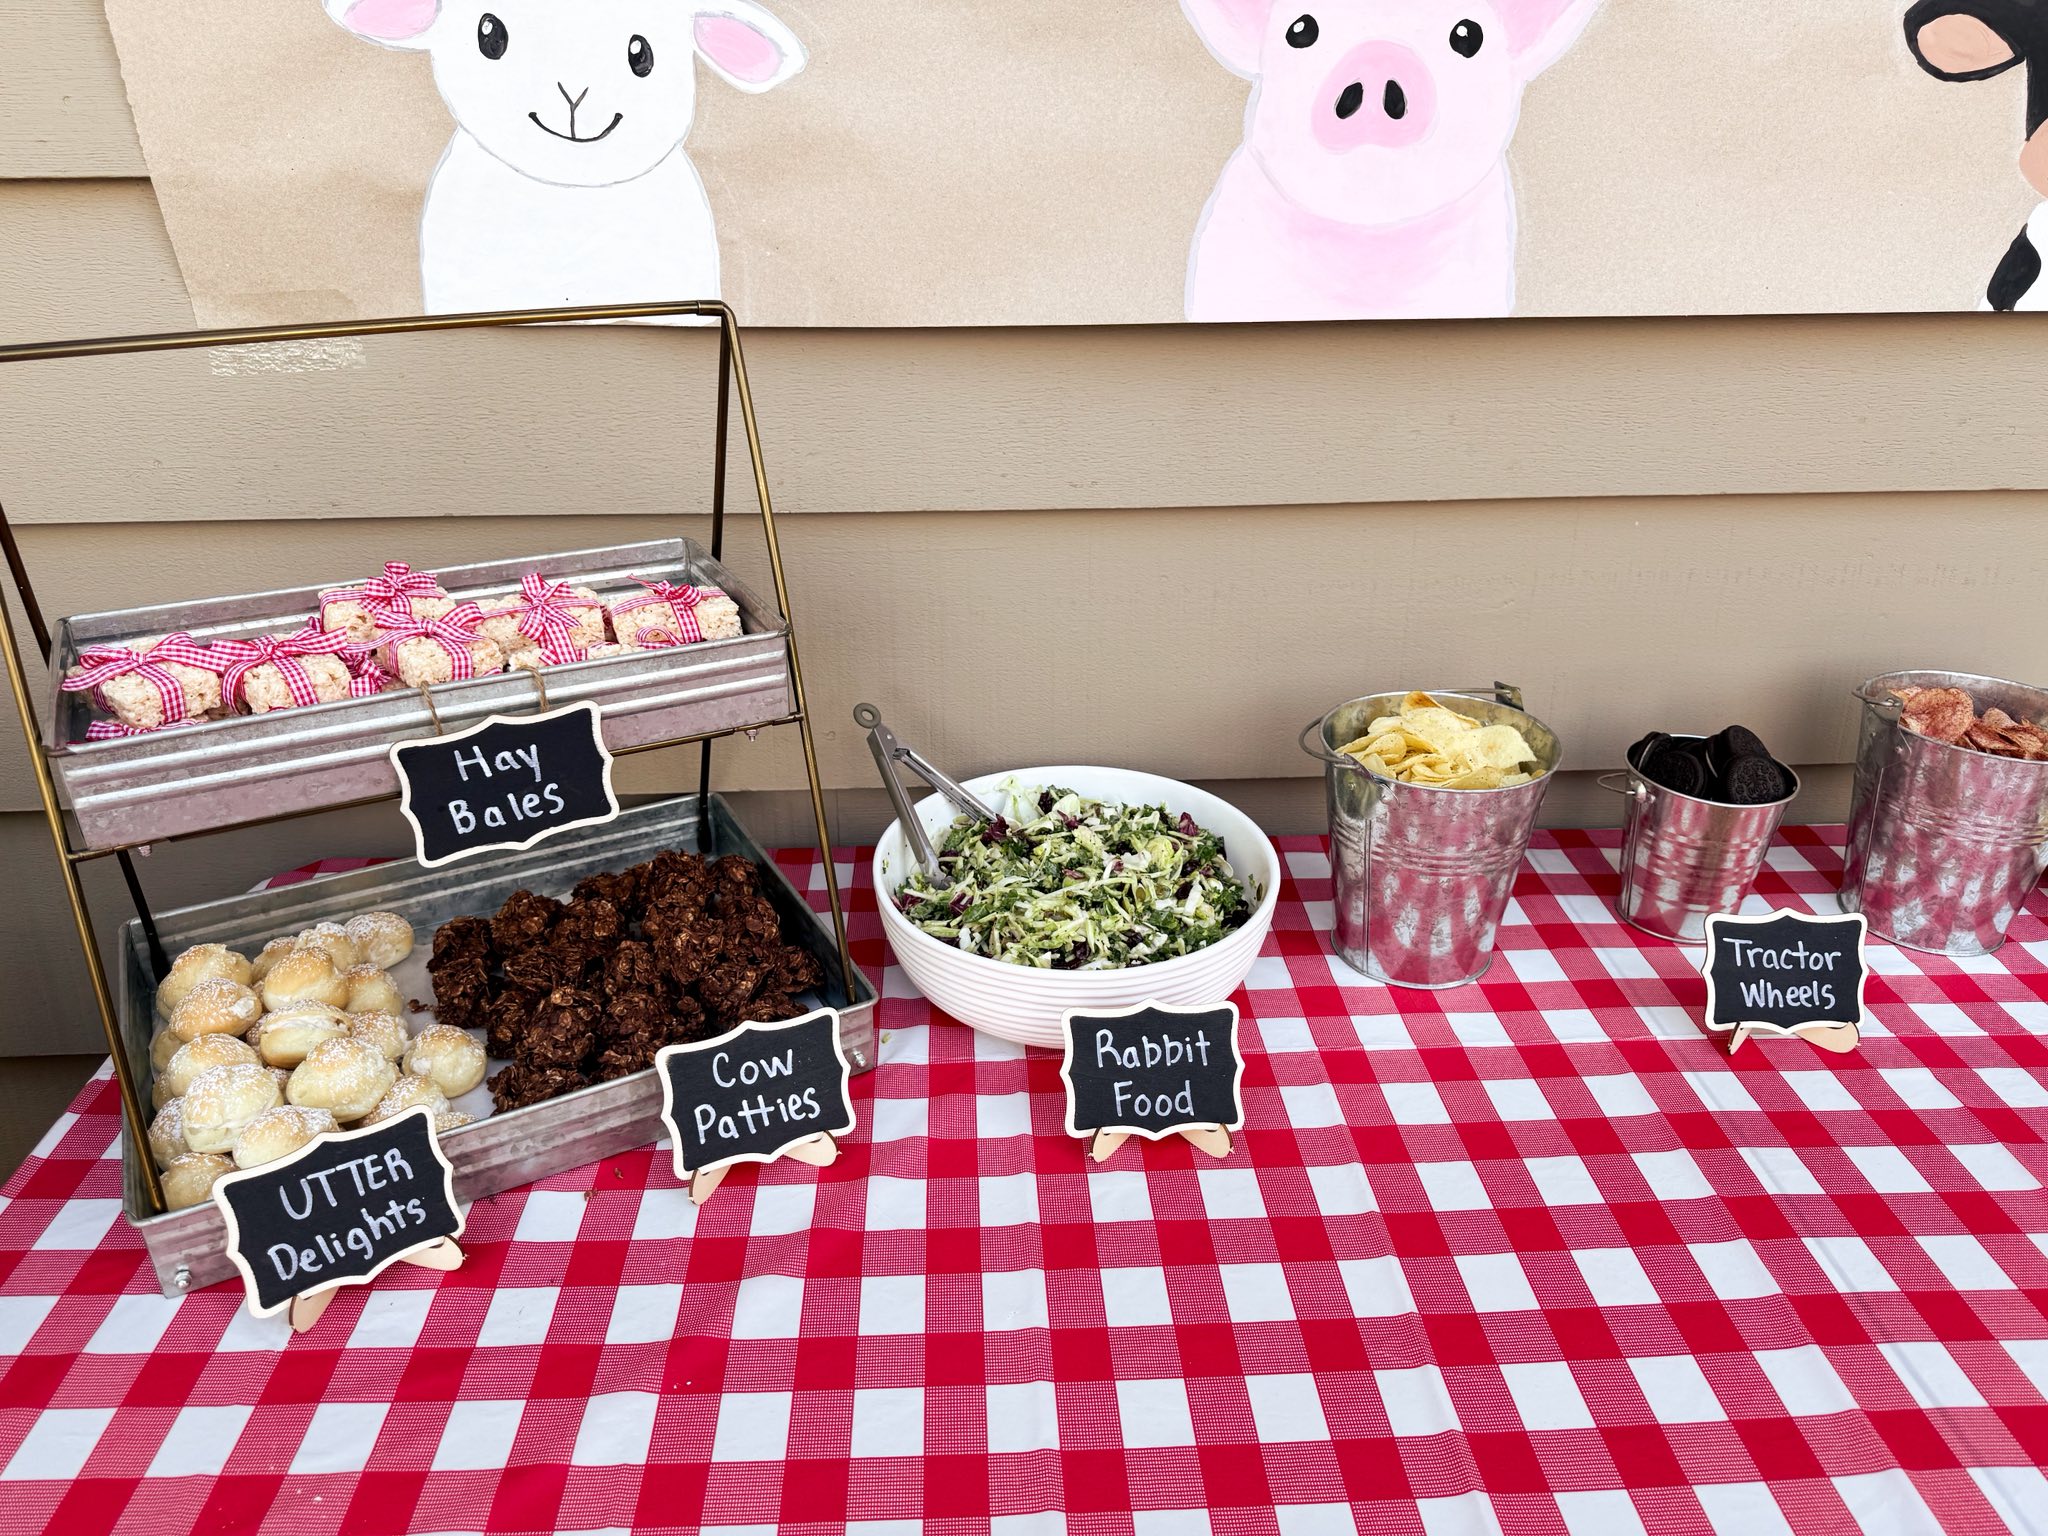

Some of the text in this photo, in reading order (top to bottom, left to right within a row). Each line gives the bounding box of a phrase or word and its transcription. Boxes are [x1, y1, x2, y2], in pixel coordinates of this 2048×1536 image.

[453, 743, 542, 783] Hay
[448, 782, 565, 835] Bales
[1723, 937, 1842, 971] Tractor
[1739, 978, 1836, 1010] Wheels
[712, 1048, 793, 1088] Cow
[1095, 1029, 1211, 1069] Rabbit
[693, 1086, 821, 1145] Patties
[1113, 1079, 1195, 1117] Food
[279, 1148, 414, 1220] UTTER
[266, 1198, 427, 1281] Delights
